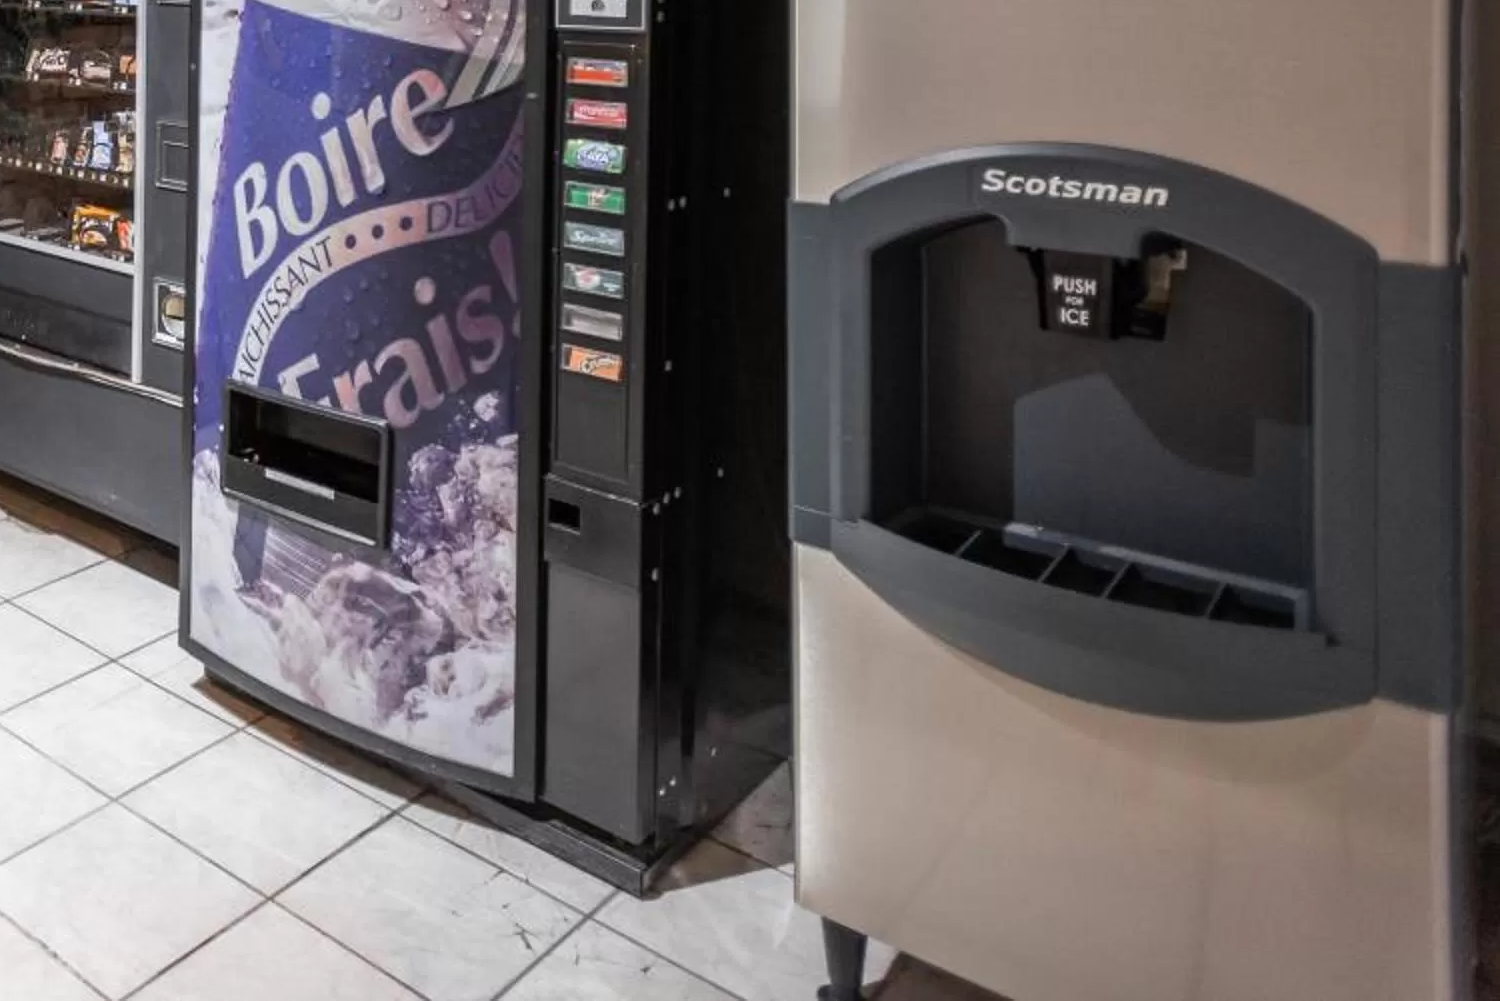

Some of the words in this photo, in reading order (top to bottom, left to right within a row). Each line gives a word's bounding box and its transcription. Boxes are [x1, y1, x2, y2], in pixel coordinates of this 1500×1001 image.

[233, 67, 455, 280] Boire
[981, 168, 1169, 206] Scotsman
[1053, 274, 1097, 296] PUSH
[1060, 308, 1089, 326] ICE
